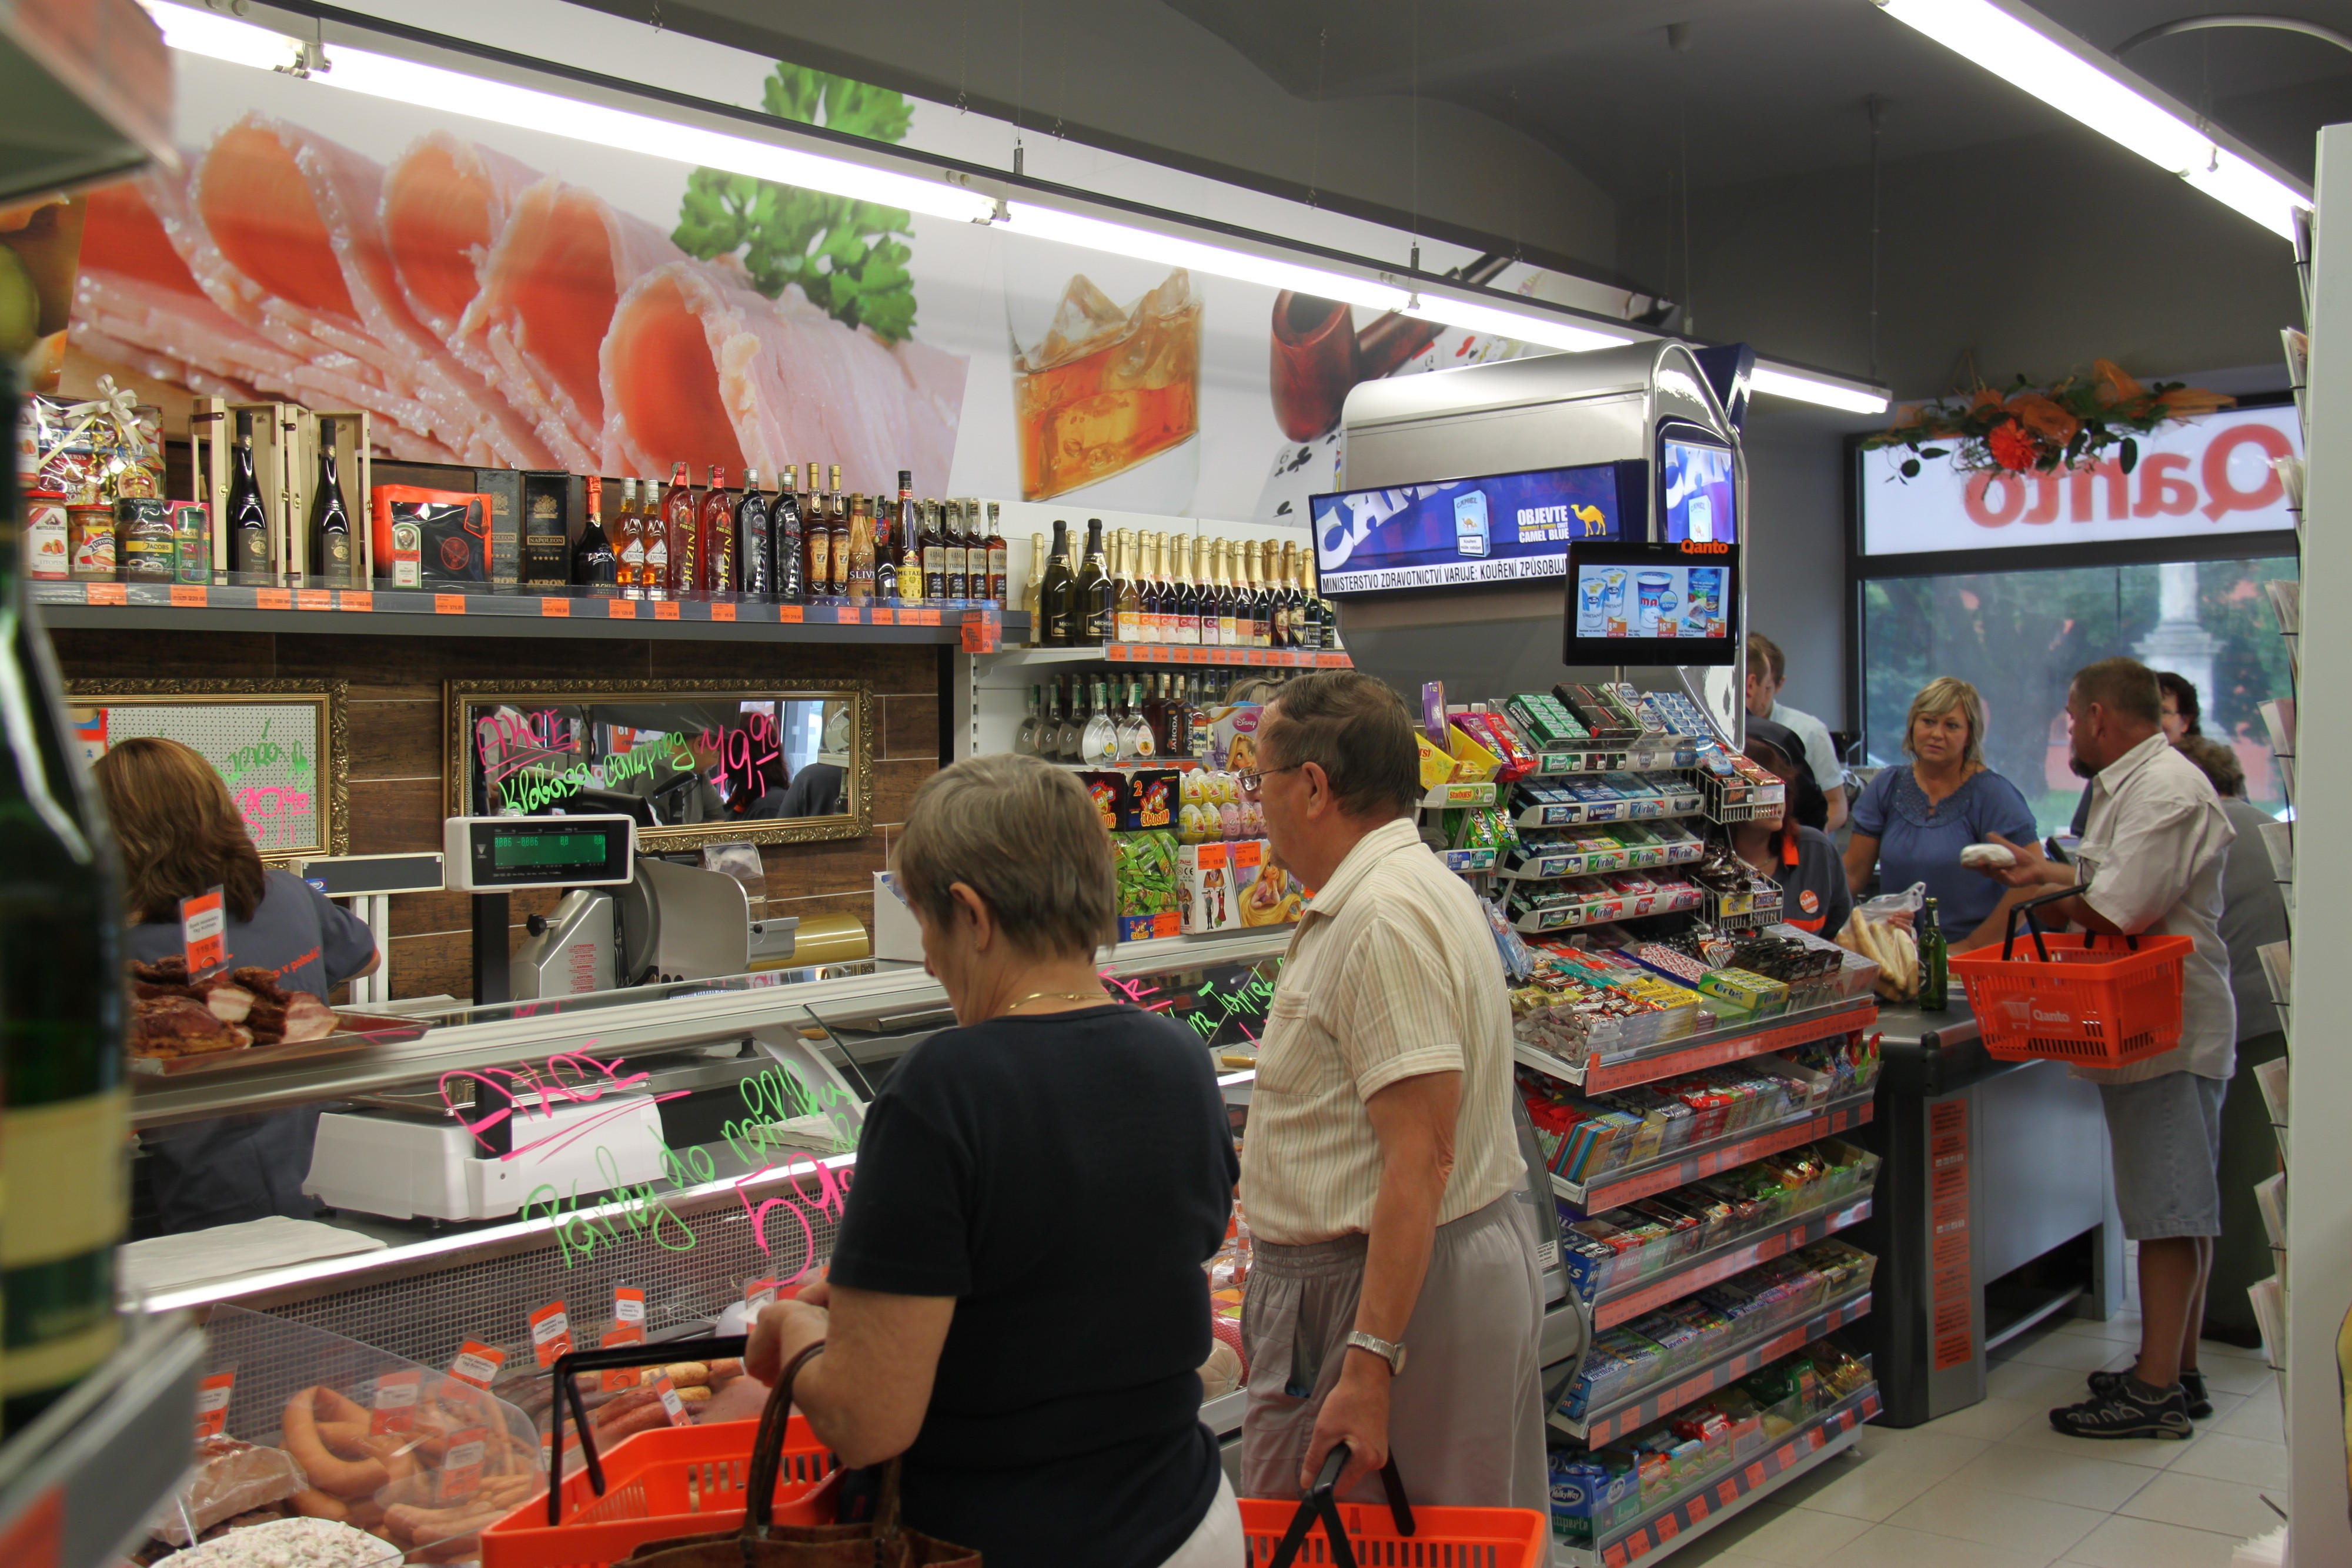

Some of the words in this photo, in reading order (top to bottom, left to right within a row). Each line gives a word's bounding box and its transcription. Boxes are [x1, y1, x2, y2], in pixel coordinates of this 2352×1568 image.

[1456, 497, 1478, 509] CAMEL
[1517, 505, 1568, 526] OBJEVTE
[1519, 530, 1546, 543] CAMEL
[1548, 528, 1569, 540] BLUE
[142, 541, 169, 550] JACOBS
[1681, 539, 1729, 554] Qanto
[684, 533, 696, 585] JELZIN
[721, 536, 732, 587] JELZIN
[754, 537, 767, 591] JELZIN
[789, 539, 801, 593] JELZIN
[1322, 573, 1378, 593] MINISTERSTVO
[1381, 565, 1443, 588] ZDRAVOTNICTVÍ
[1444, 564, 1478, 582] VARUJE:
[1480, 559, 1518, 580] KOUŘENÍ
[1521, 556, 1566, 576] ZPŮSOBUJ
[476, 708, 571, 765] AKCE
[497, 761, 596, 815] Klobása
[1133, 780, 1142, 797] 2
[1449, 790, 1472, 800] Starburst
[1637, 803, 1655, 815] Orbit
[1141, 809, 1170, 827] EXPLOSION
[560, 835, 569, 847] 0,0
[594, 835, 602, 846] 0,0
[1636, 852, 1654, 862] Orbit
[1676, 848, 1692, 858] Orbit
[1596, 857, 1615, 868] Orbit
[1676, 895, 1692, 906] Orbit
[1594, 907, 1613, 918] Orbit
[1713, 982, 1743, 1001] Orbit
[2033, 1009, 2070, 1023] Qanto
[438, 1038, 650, 1153] AKCE
[647, 1124, 716, 1188] do
[1618, 1253, 1642, 1272] HALLS
[1591, 1366, 1615, 1380] mentos
